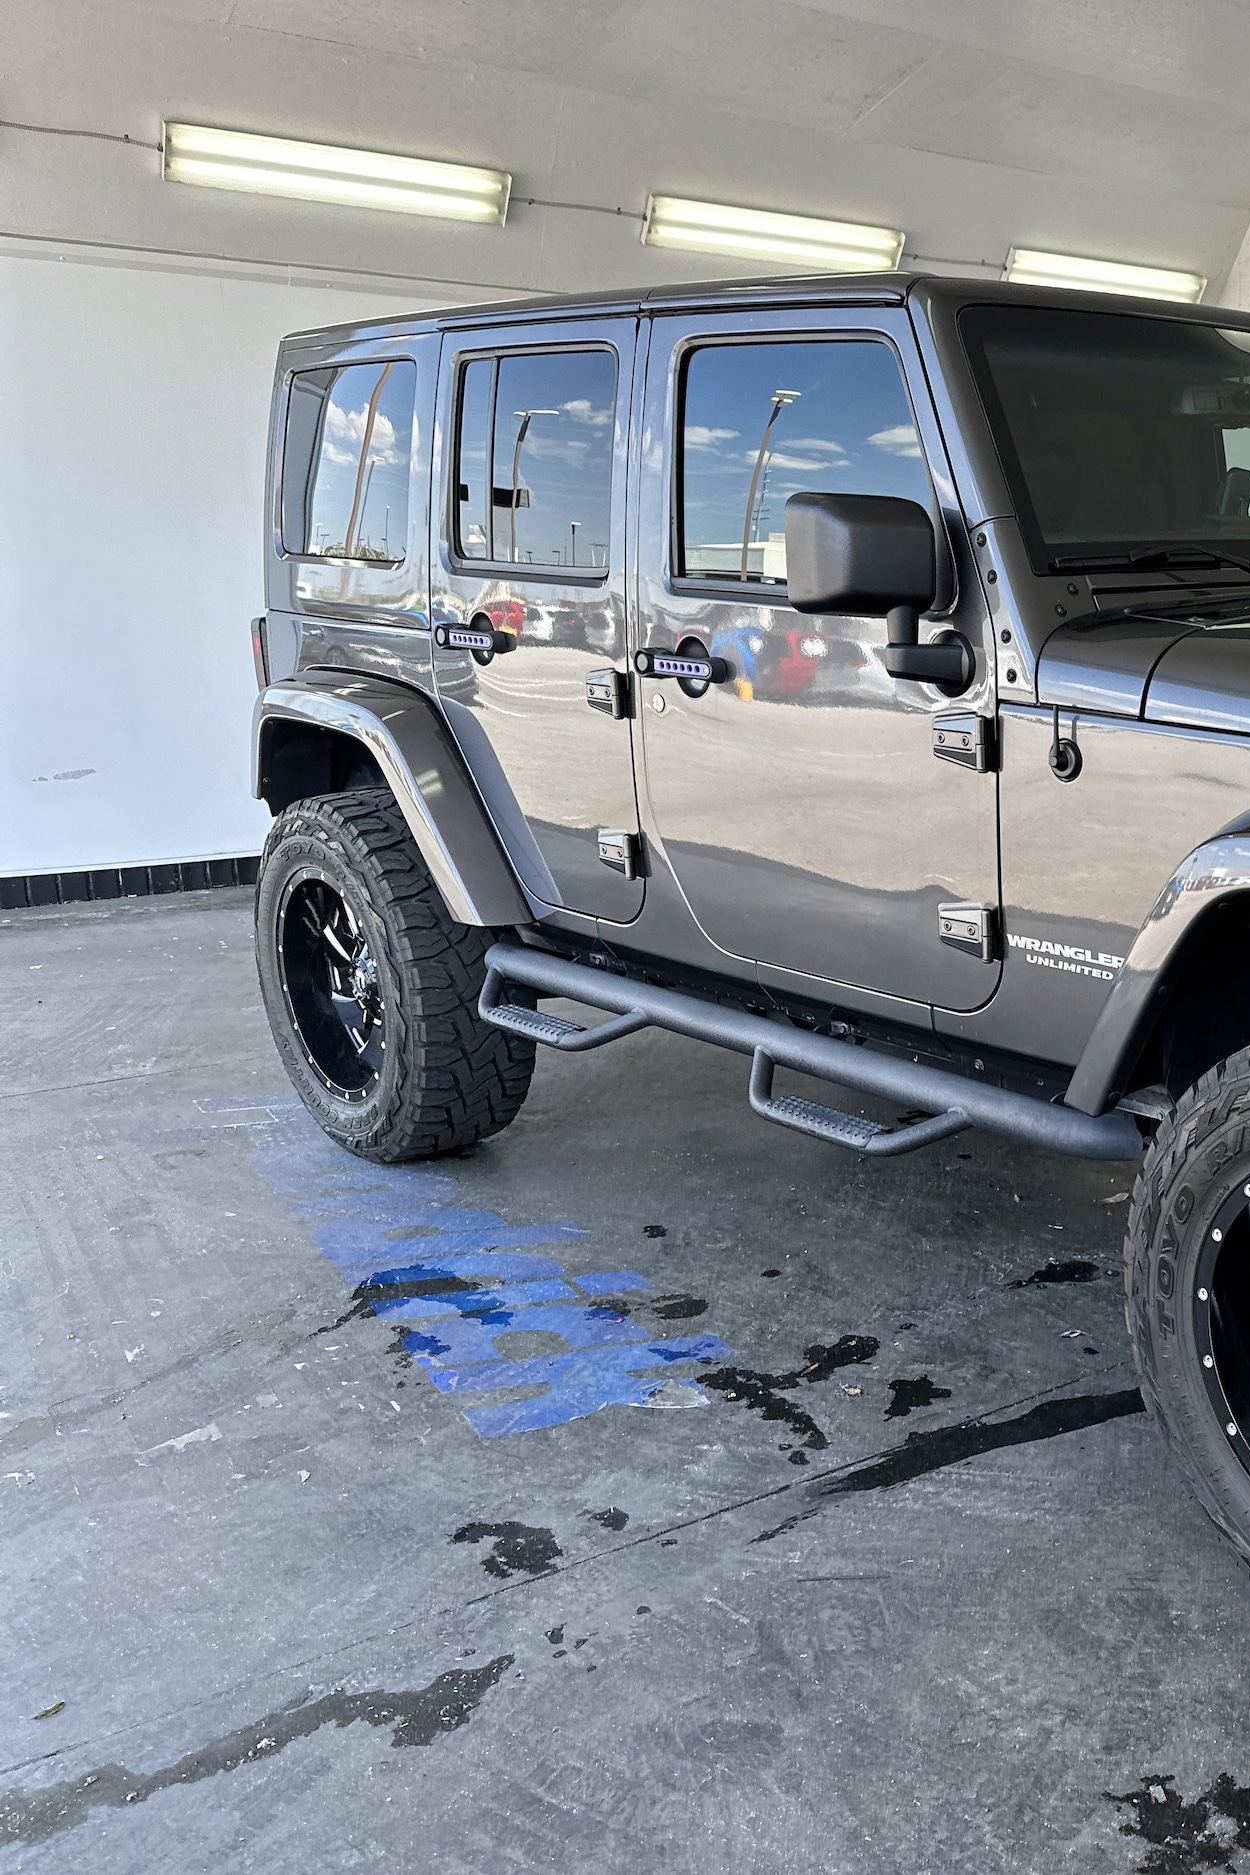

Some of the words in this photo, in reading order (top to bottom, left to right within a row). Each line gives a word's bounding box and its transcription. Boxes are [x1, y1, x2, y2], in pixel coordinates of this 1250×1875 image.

[1006, 934, 1125, 969] WRANGLER
[1026, 953, 1114, 980] UNLIMITED
[1156, 1183, 1195, 1341] TOYO
